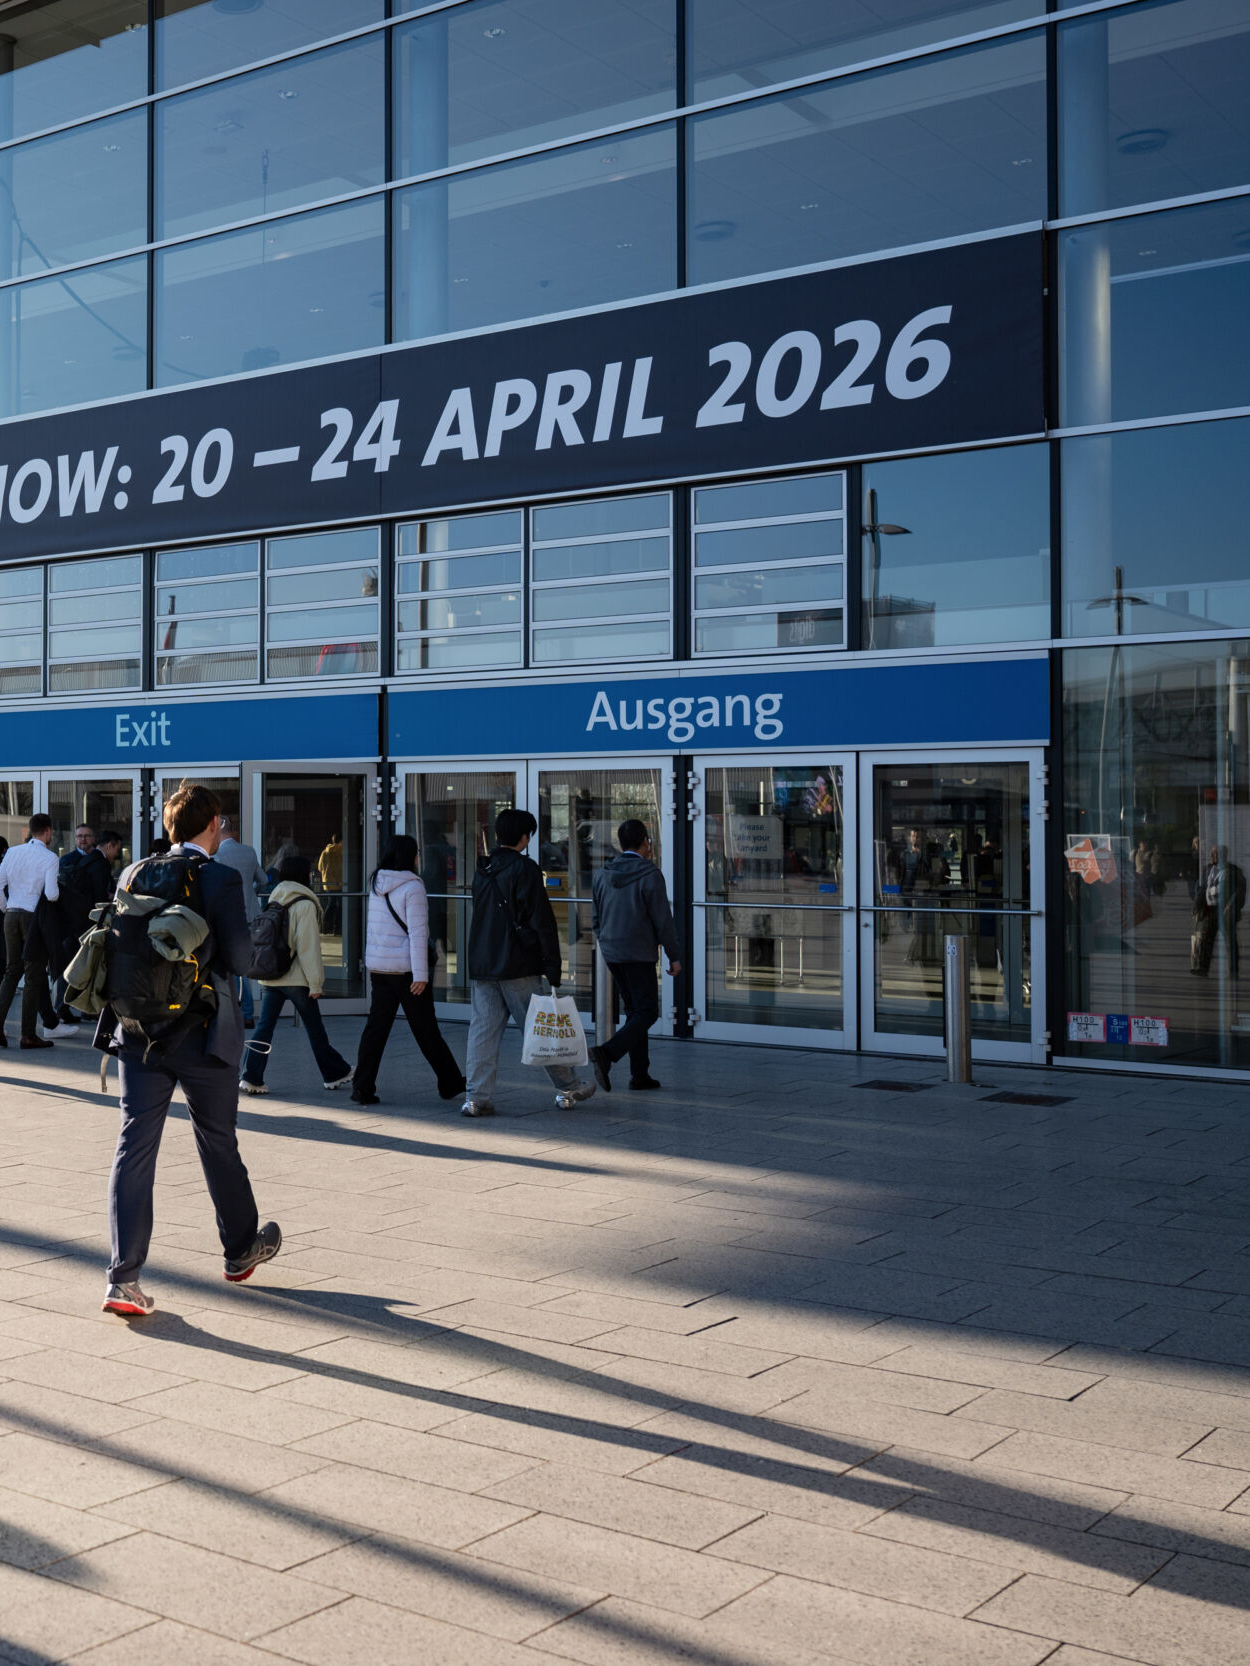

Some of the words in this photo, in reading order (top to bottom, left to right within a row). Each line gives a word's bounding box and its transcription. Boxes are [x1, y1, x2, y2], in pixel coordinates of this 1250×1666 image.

[152, 427, 234, 505] 20
[311, 398, 401, 482] 24
[421, 356, 664, 467] APRIL
[696, 305, 953, 428] 2026
[585, 691, 784, 743] Ausgang
[115, 711, 171, 748] Exit
[739, 823, 765, 831] Please
[753, 835, 770, 843] your
[1072, 1015, 1095, 1024] H100
[1133, 1019, 1156, 1028] H100
